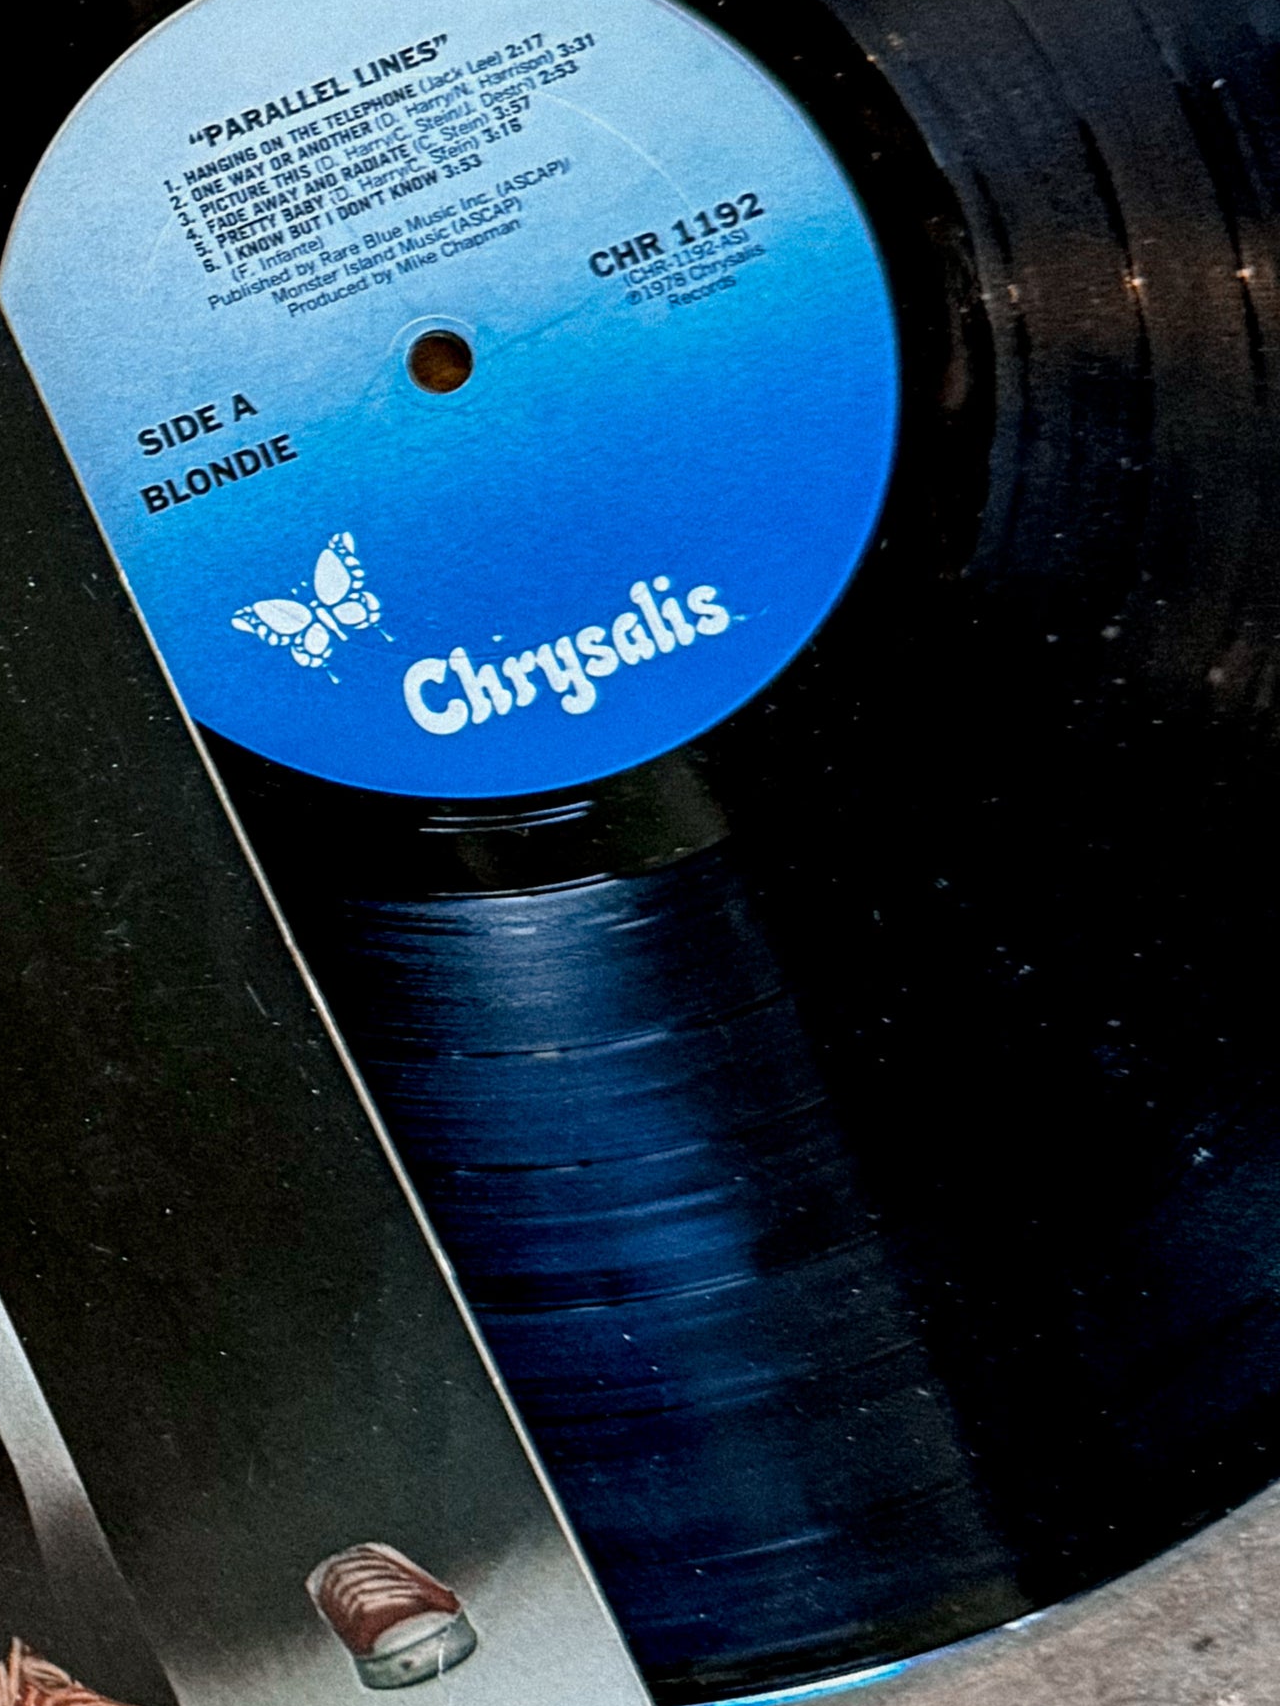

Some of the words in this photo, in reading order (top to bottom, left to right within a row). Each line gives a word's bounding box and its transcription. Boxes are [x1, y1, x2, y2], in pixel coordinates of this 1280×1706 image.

[163, 179, 182, 194] 1.
[183, 147, 258, 186] HANGING
[260, 136, 285, 155] ON
[287, 121, 321, 145] THE
[323, 83, 418, 135] TELEPHONE
[418, 66, 463, 94] (Jack
[466, 51, 503, 74] Lee)
[505, 33, 544, 59] 2:17
[170, 195, 188, 211] 2.
[191, 178, 228, 202] ONE
[228, 161, 266, 186] WAY
[269, 152, 294, 171] OR
[298, 120, 373, 160] ANOTHER
[375, 111, 400, 131] (D.
[478, 49, 554, 89] Harrison)
[557, 32, 596, 58] 3:31
[178, 211, 195, 227] 3.
[199, 181, 271, 219] PICTURE
[272, 164, 312, 190] THIS
[314, 154, 339, 174] (D.
[539, 59, 580, 85] 2:53
[185, 227, 203, 241] 4.
[206, 210, 249, 234] FADE
[253, 187, 303, 217] AWAY
[305, 173, 339, 196] AND
[341, 144, 410, 182] RADIATE
[412, 134, 437, 154] (C.
[440, 114, 489, 142] Stein)
[492, 94, 531, 121] 3:57
[193, 242, 212, 258] 5.
[215, 214, 279, 249] PRETTY
[282, 194, 324, 223] BABY
[429, 137, 480, 165] Stein)
[203, 258, 221, 274] 6.
[223, 250, 234, 265] I
[235, 230, 286, 261] KNOW
[290, 215, 324, 240] BUT
[325, 211, 335, 225] I
[336, 191, 386, 221] DON'T
[389, 169, 439, 201] KNOW
[442, 153, 483, 179] 3:53
[208, 269, 292, 311] Published
[295, 260, 315, 277] by
[319, 243, 360, 267] Rare
[362, 226, 404, 249] Blue
[405, 205, 458, 233] Music
[459, 193, 493, 211] Inc.
[271, 270, 339, 305] Monster
[343, 248, 396, 276] Island
[398, 227, 452, 254] Music
[451, 196, 523, 235] (ASCAP)
[589, 232, 666, 278] CHR
[670, 192, 765, 246] 1192
[232, 263, 256, 283] (F.
[259, 235, 325, 271] Infante)
[287, 278, 370, 318] Produced
[373, 268, 392, 285] by
[396, 250, 439, 276] Mike
[440, 218, 523, 258] Chapman
[668, 274, 737, 309] Records
[690, 244, 766, 280] Chrysalis
[137, 404, 224, 456] SIDE
[231, 393, 259, 422] A
[139, 434, 298, 515] BLONDIE
[403, 575, 730, 735] Chrysalis
